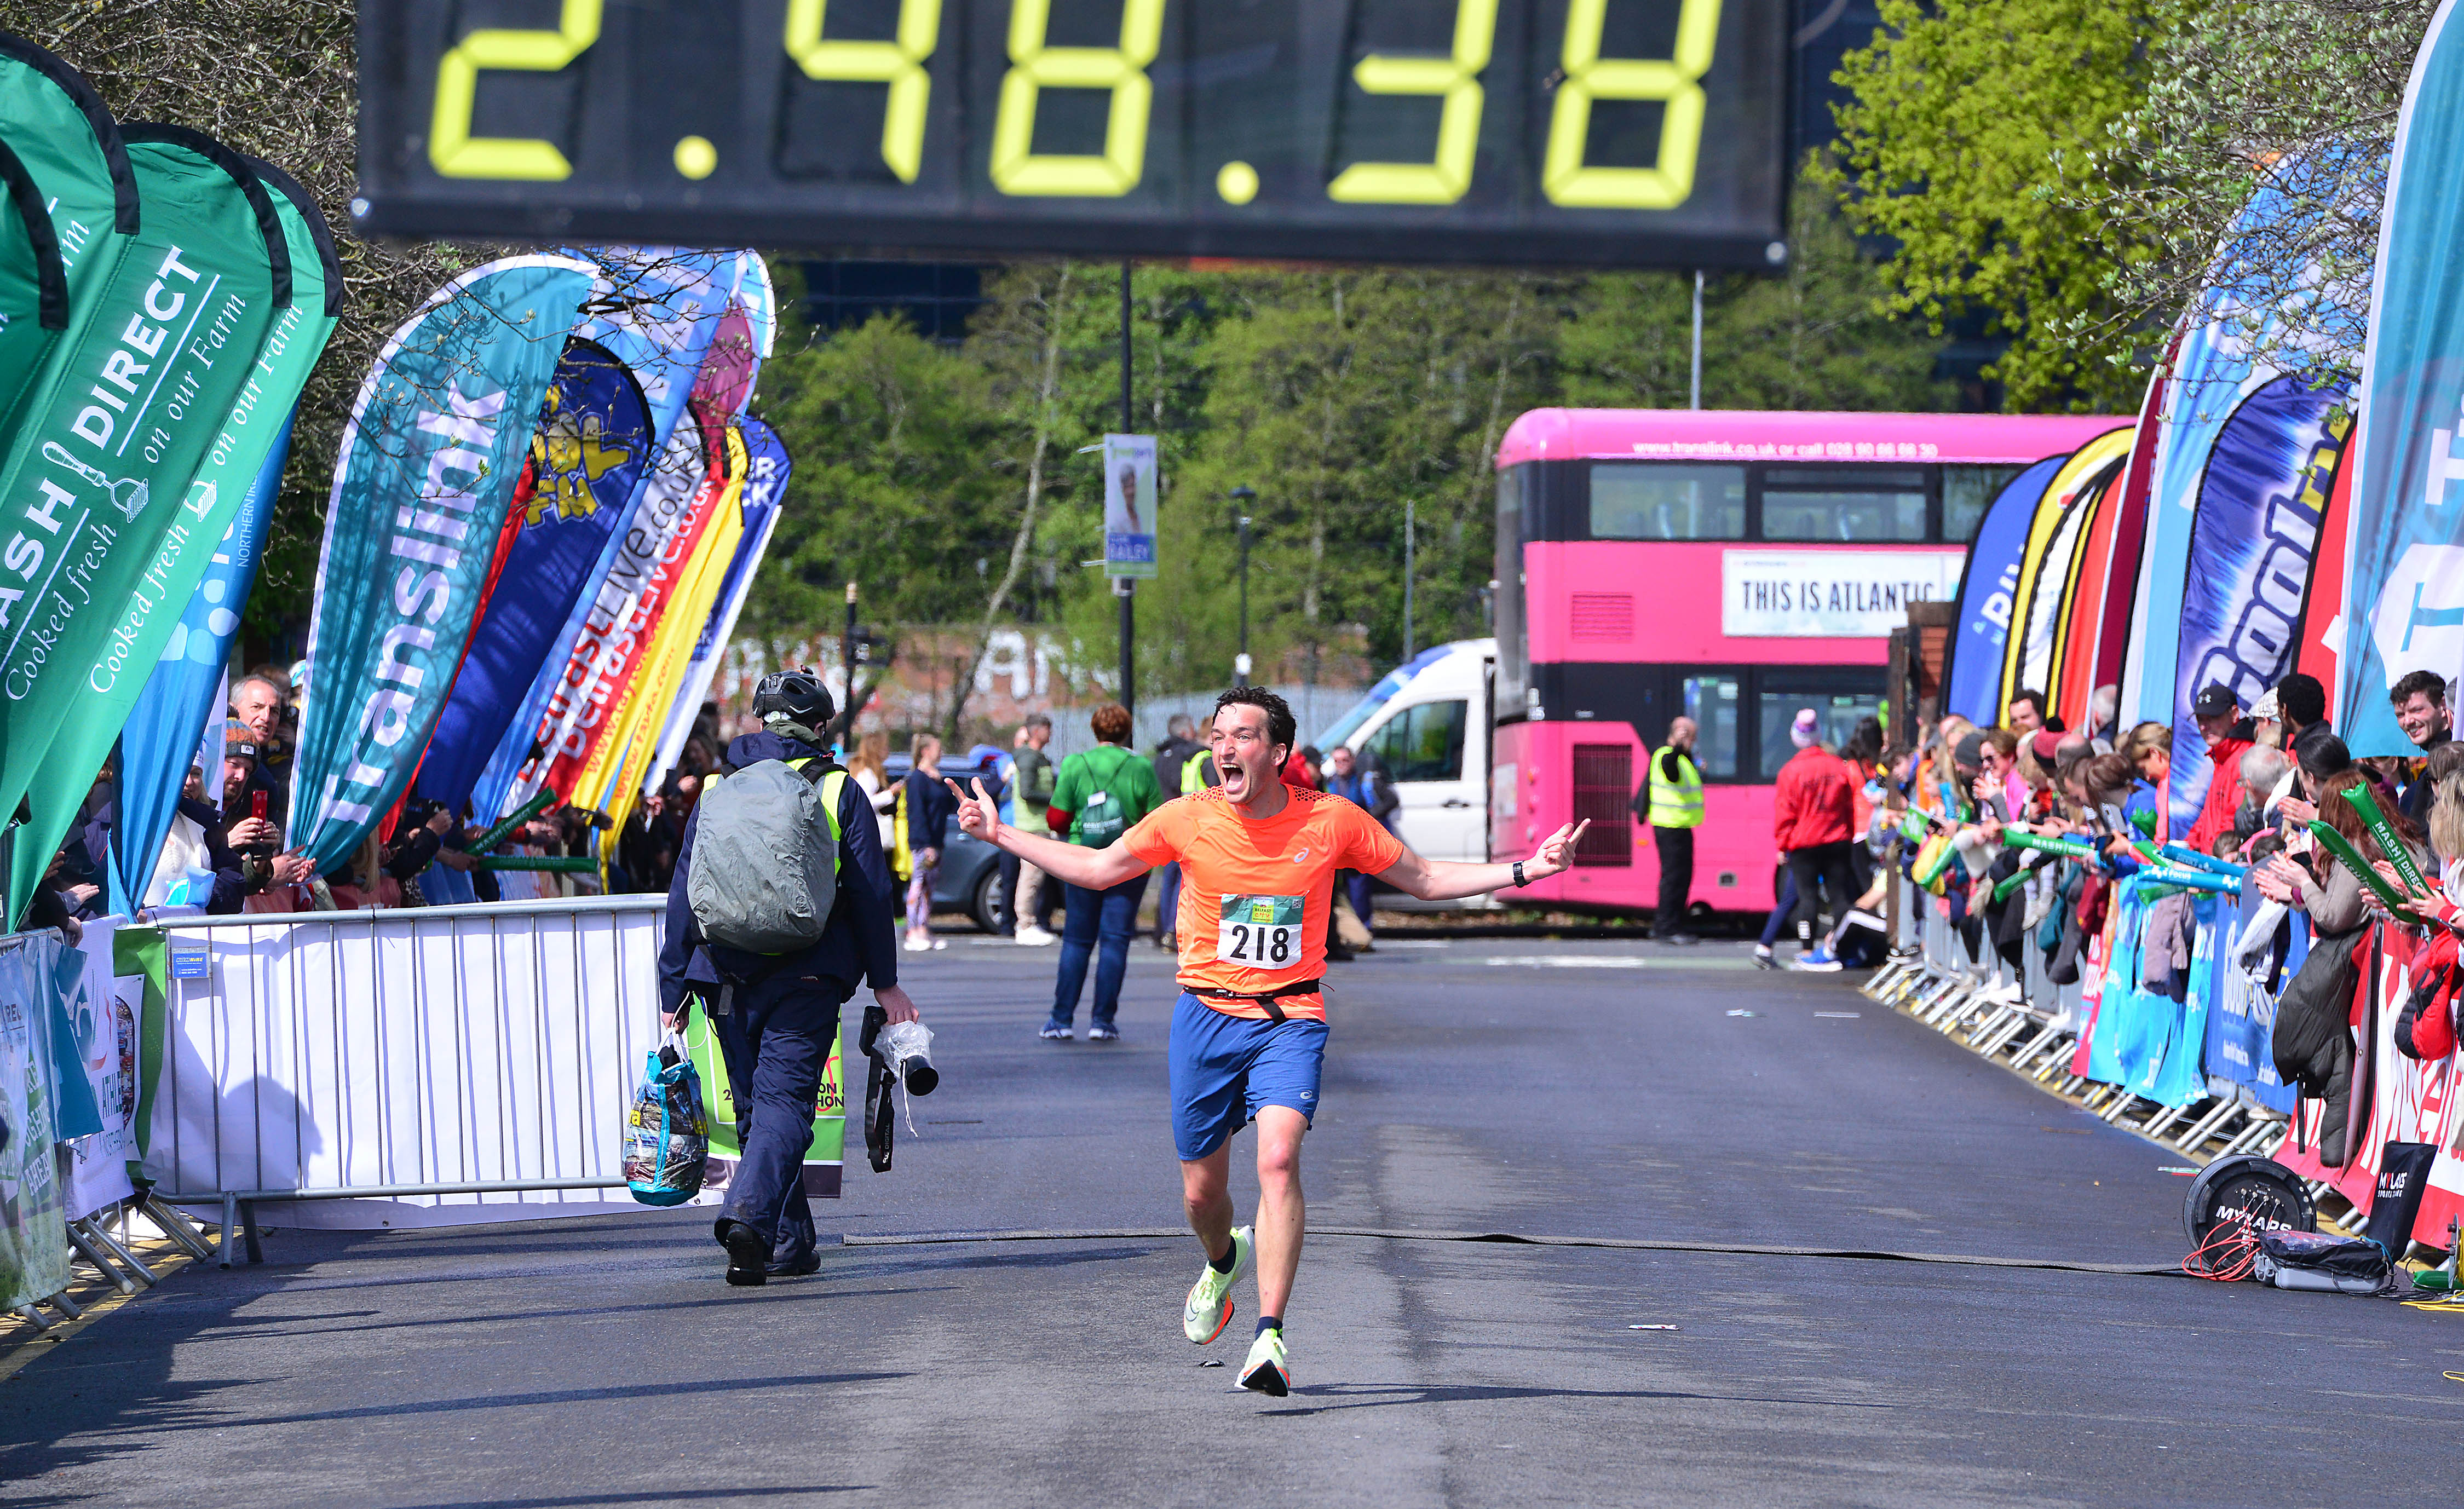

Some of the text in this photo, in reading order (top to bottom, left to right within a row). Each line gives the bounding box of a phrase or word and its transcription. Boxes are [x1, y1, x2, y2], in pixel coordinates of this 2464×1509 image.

[70, 245, 201, 450] DIRECT
[5, 293, 246, 701] Cooked fresh on our Farm
[90, 302, 304, 693] Cooked fresh on our Farm
[237, 497, 255, 567] NORTHERN
[307, 377, 508, 846] Translink
[1742, 580, 1934, 612] THIS IS ATLANTIC
[2032, 838, 2063, 851] MASH
[2375, 821, 2402, 857] MASH
[2401, 860, 2426, 891] DIREC
[1230, 925, 1289, 963] 218
[2215, 1205, 2292, 1231] MYLAPS
